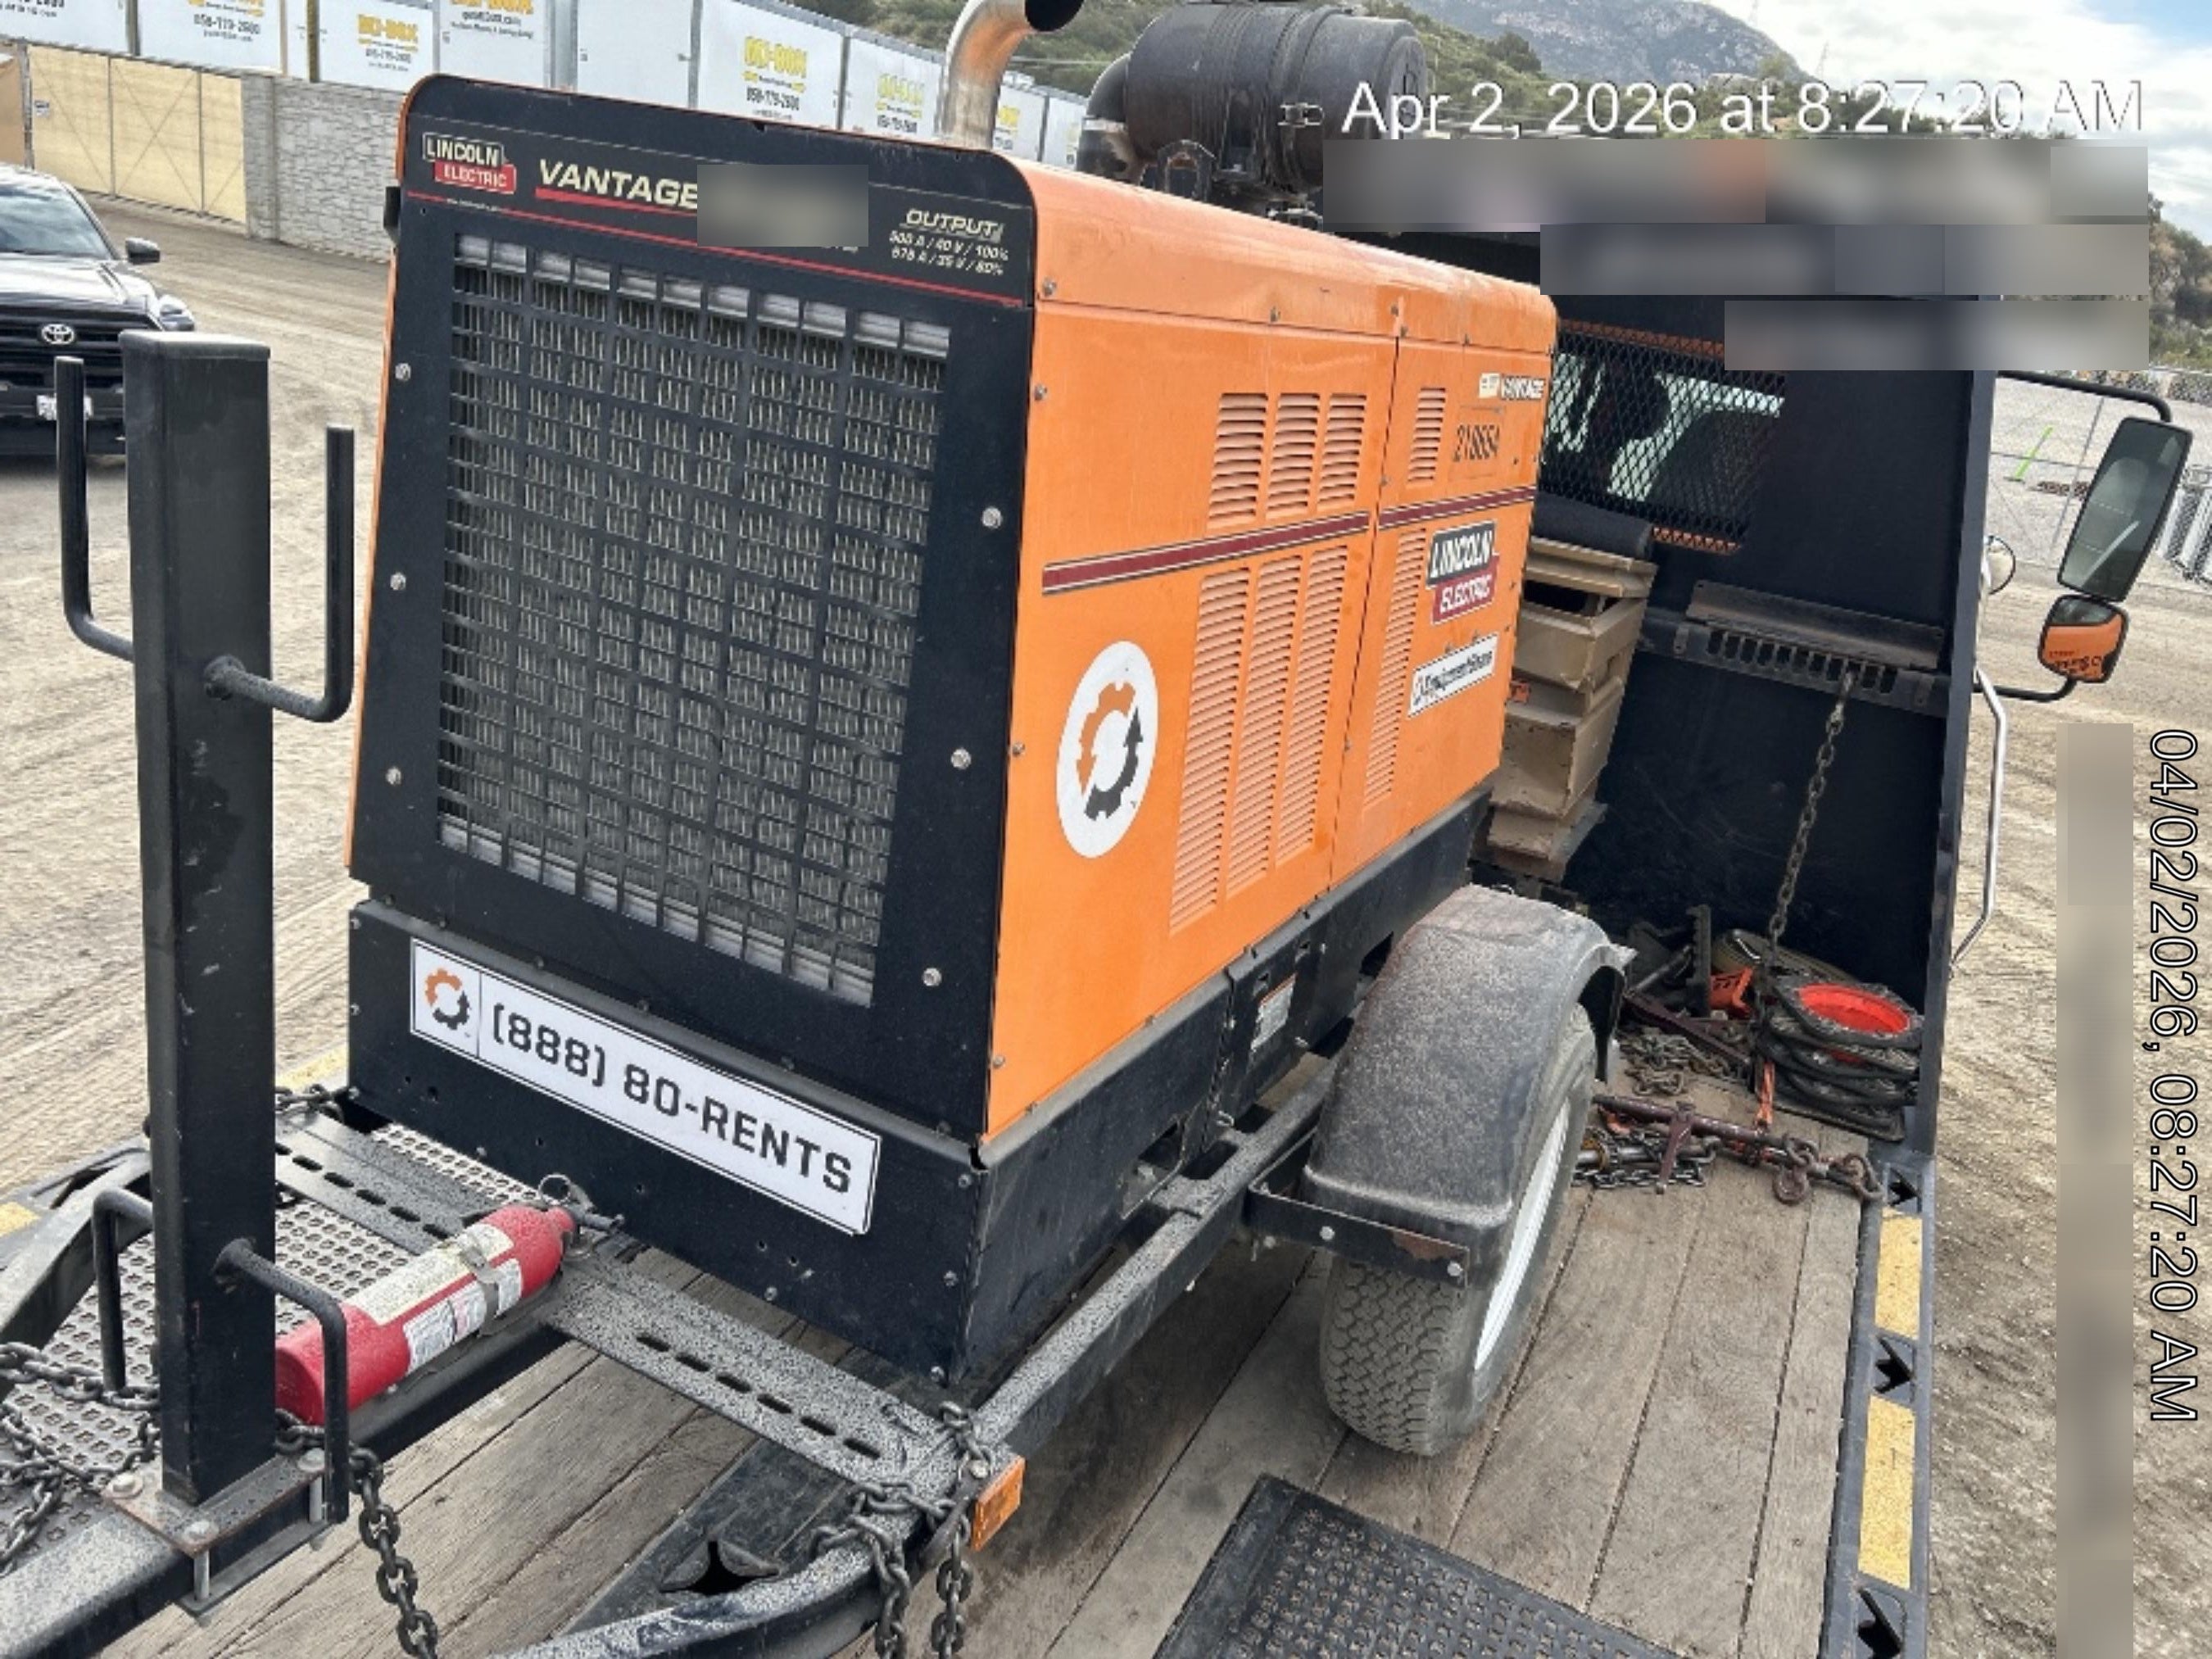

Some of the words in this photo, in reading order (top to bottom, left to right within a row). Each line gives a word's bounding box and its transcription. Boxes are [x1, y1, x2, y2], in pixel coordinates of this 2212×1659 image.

[426, 136, 500, 167] LINCOLN
[443, 161, 508, 188] ELECTRIC
[539, 158, 697, 210] VANTAGE
[905, 208, 1000, 237] OUTPUT
[975, 244, 1009, 261] 100%
[1429, 530, 1494, 578] LINCOLN
[1439, 574, 1493, 614] ELECTRIC
[492, 1002, 606, 1087] (888)
[623, 1063, 852, 1194] 80-RENTS
